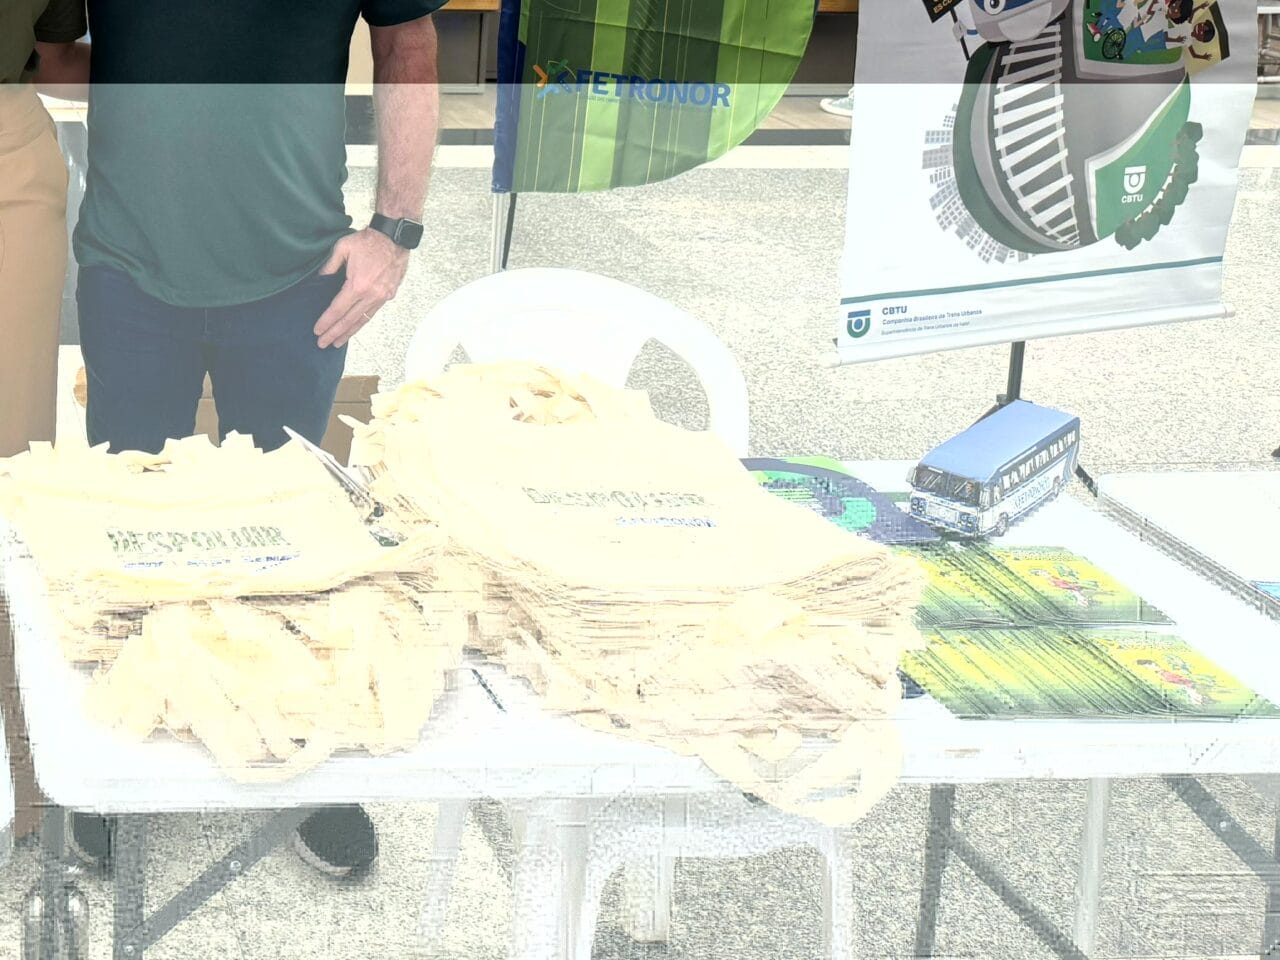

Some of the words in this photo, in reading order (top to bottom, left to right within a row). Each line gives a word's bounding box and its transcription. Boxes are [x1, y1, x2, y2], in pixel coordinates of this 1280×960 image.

[575, 68, 731, 108] FETRONOR
[1121, 194, 1143, 204] CBTU
[882, 305, 908, 315] CBTU
